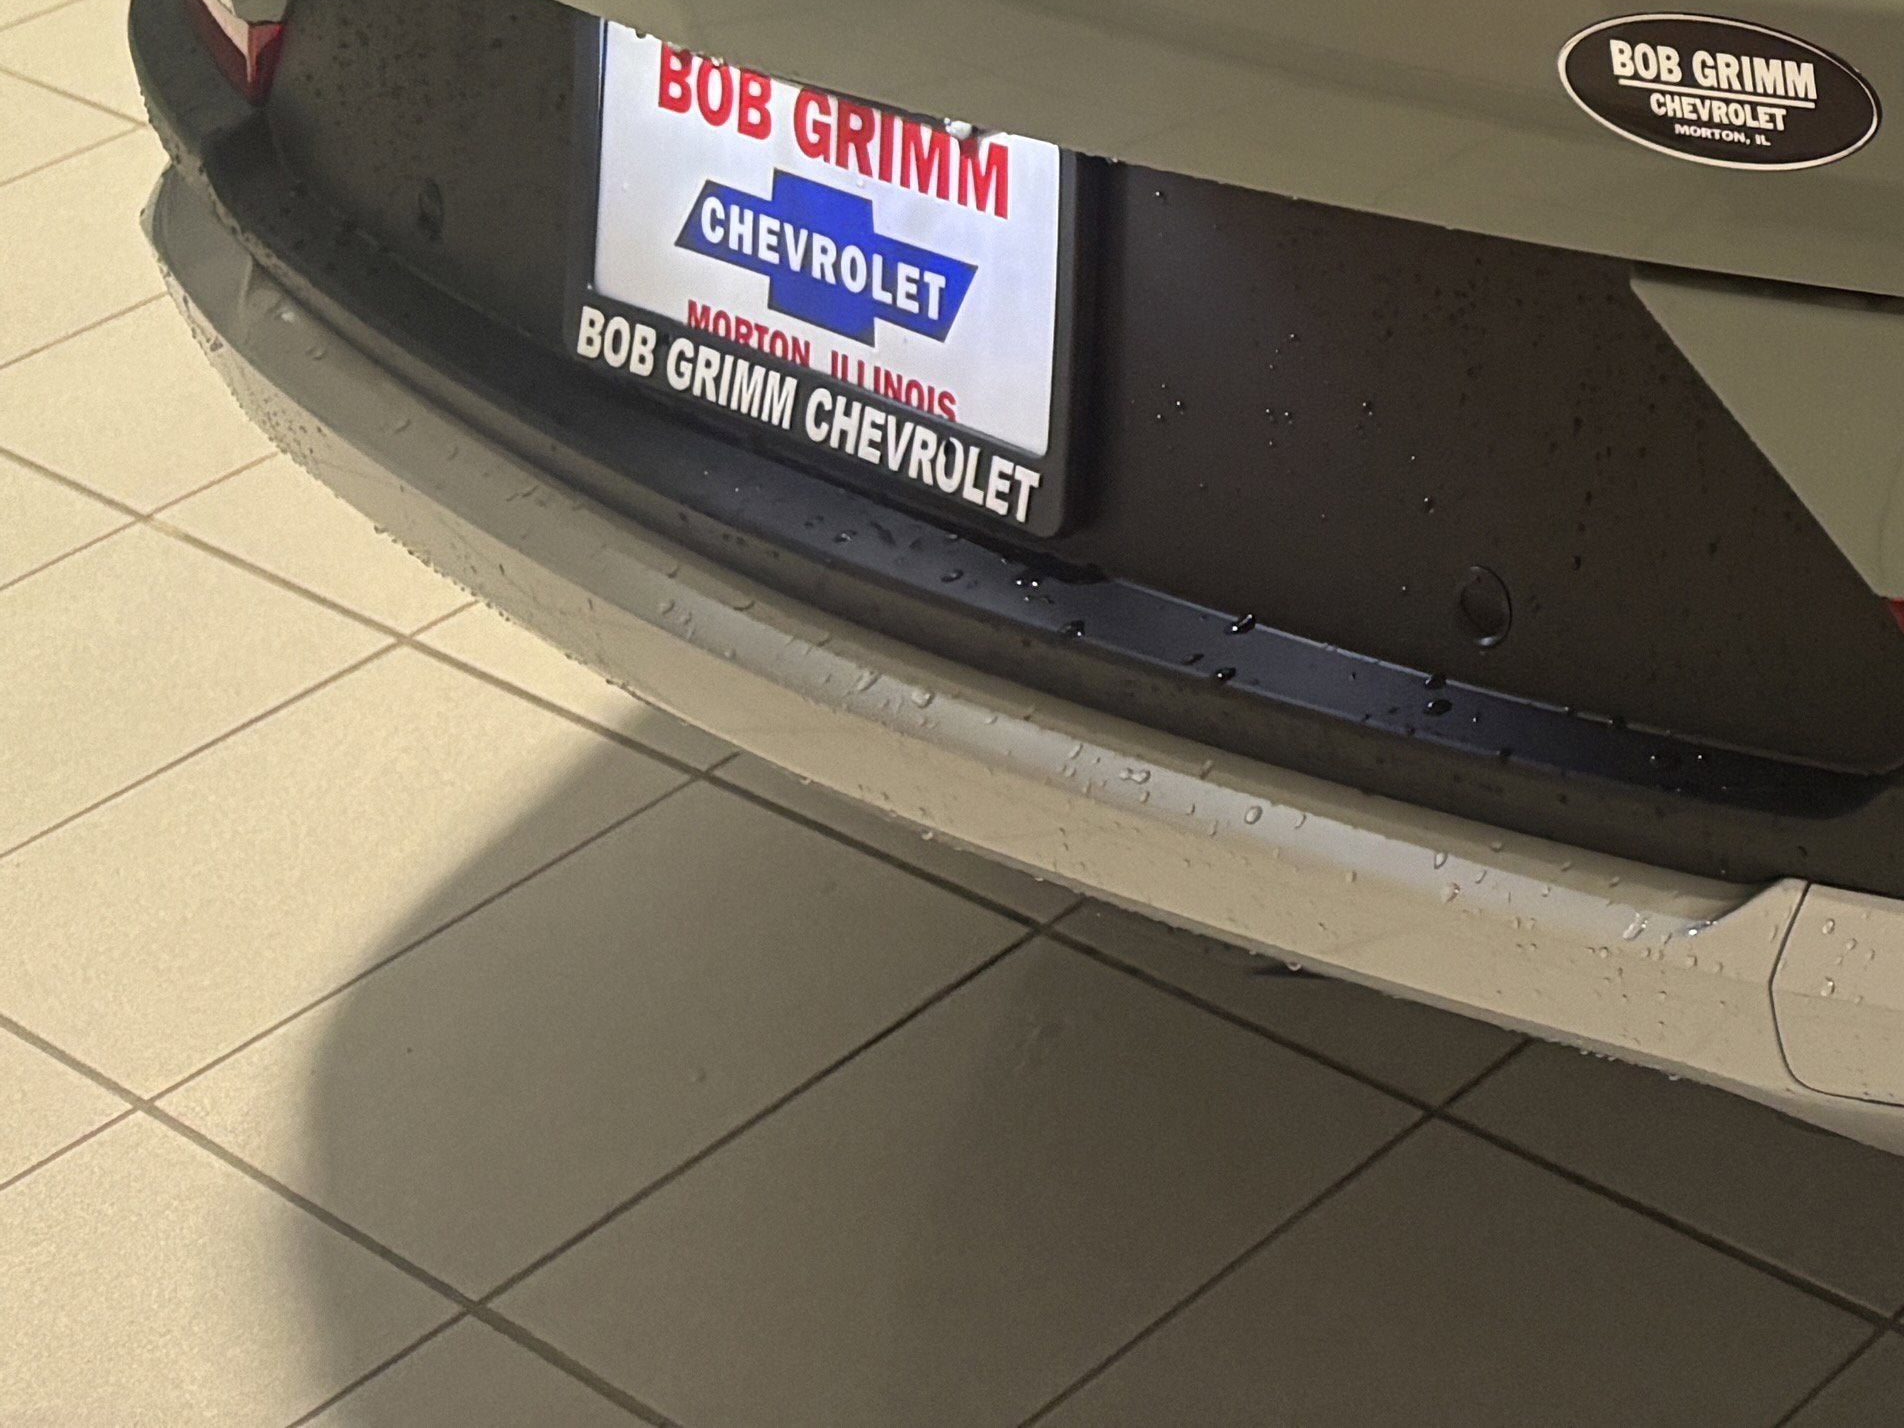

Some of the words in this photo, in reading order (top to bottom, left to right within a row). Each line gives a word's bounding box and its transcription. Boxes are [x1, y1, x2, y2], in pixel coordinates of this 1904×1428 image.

[657, 41, 773, 141] BOB
[793, 86, 1010, 220] GRIMM
[1609, 39, 1682, 83] BOB
[1692, 49, 1818, 100] GRIMM
[1650, 93, 1787, 132] CHEVROLET
[1674, 123, 1752, 145] MORTON,
[1755, 134, 1772, 147] IL
[700, 197, 946, 321] CHEVROLET
[577, 305, 657, 377] BOB
[666, 337, 797, 430] GRIMM
[805, 387, 1041, 523] CHEVROLET
[686, 299, 811, 366] MORTON
[829, 350, 958, 423] ILLINOIS
